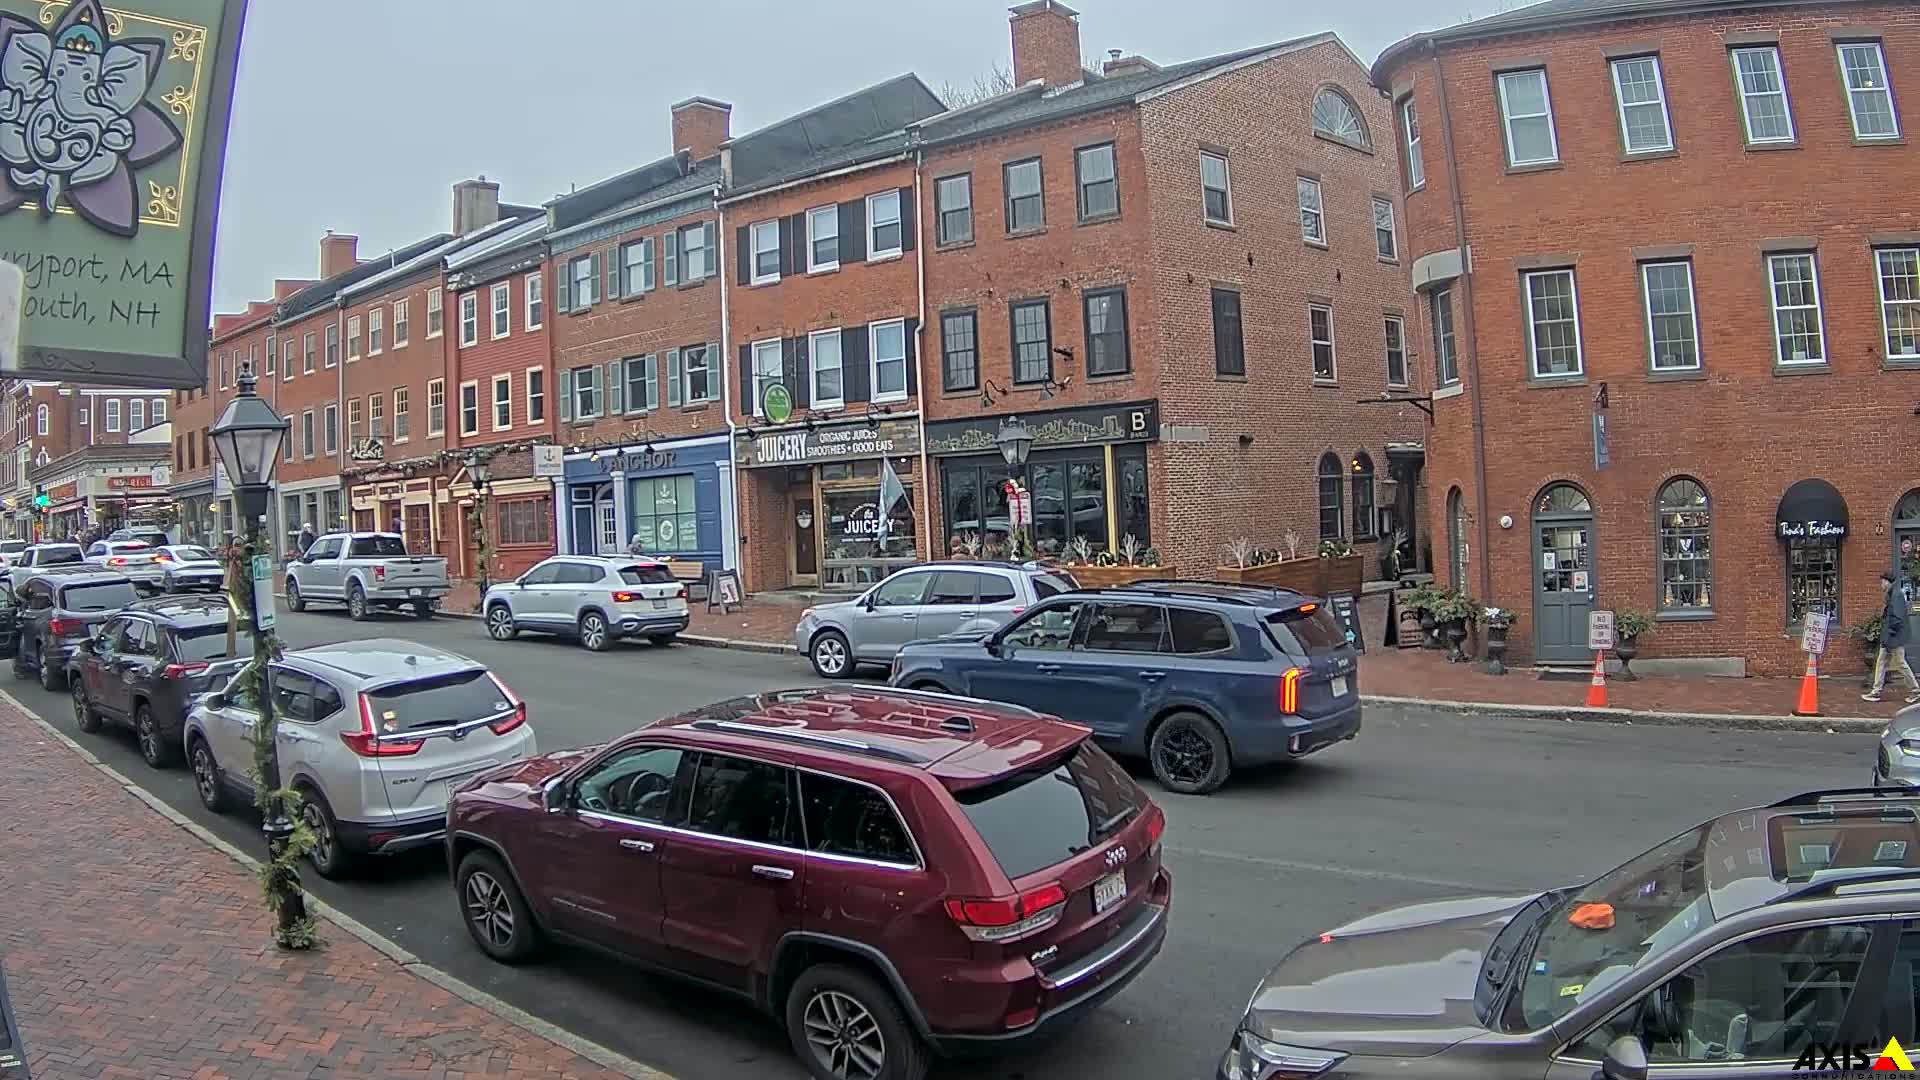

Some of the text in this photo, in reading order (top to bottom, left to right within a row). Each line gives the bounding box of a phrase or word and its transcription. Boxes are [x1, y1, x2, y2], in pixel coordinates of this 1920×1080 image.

[120, 259, 175, 288] MA
[109, 300, 160, 328] NH
[820, 429, 877, 443] ORGANIC JUICES
[757, 433, 807, 462] JUICERY
[806, 439, 894, 457] SMOOTHIES GOOD EATS
[610, 451, 675, 472] ANCHOR
[844, 518, 895, 534] JUICEY
